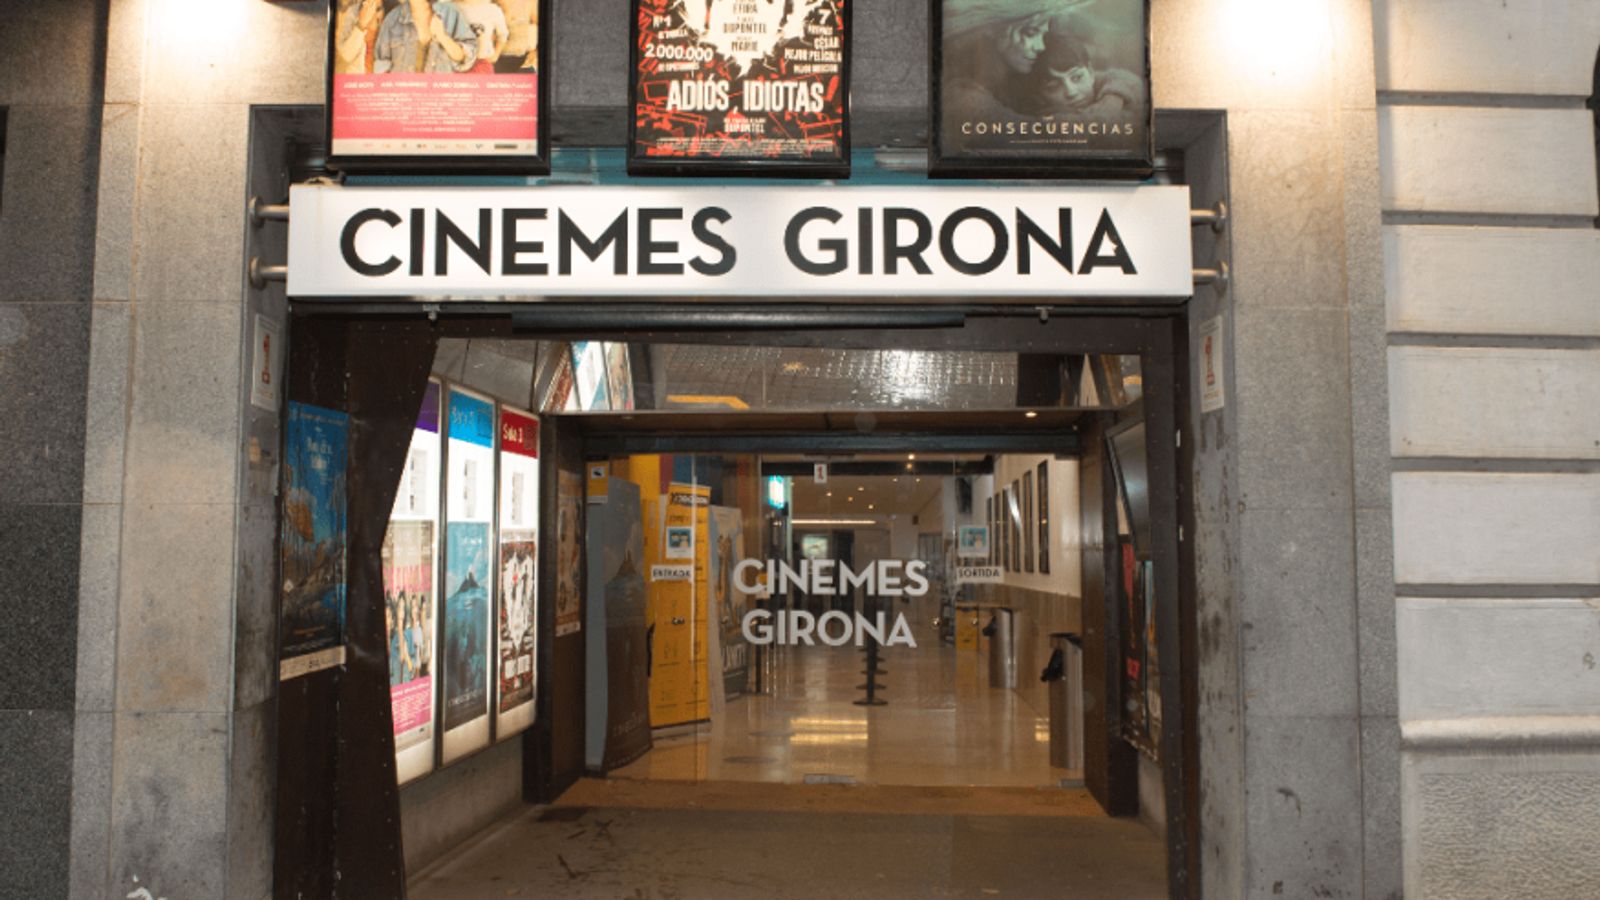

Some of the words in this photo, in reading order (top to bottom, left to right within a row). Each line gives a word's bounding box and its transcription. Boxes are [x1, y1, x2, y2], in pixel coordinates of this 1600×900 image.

[818, 8, 832, 25] 7
[743, 79, 824, 113] IDIOTAS
[961, 122, 1134, 135] CONSECUENCIAS
[340, 206, 737, 277] CINEMES
[784, 206, 1138, 276] GIRONA
[733, 559, 929, 596] CINEMES
[958, 569, 1000, 578] SORTIDA
[741, 608, 917, 648] GIRONA
